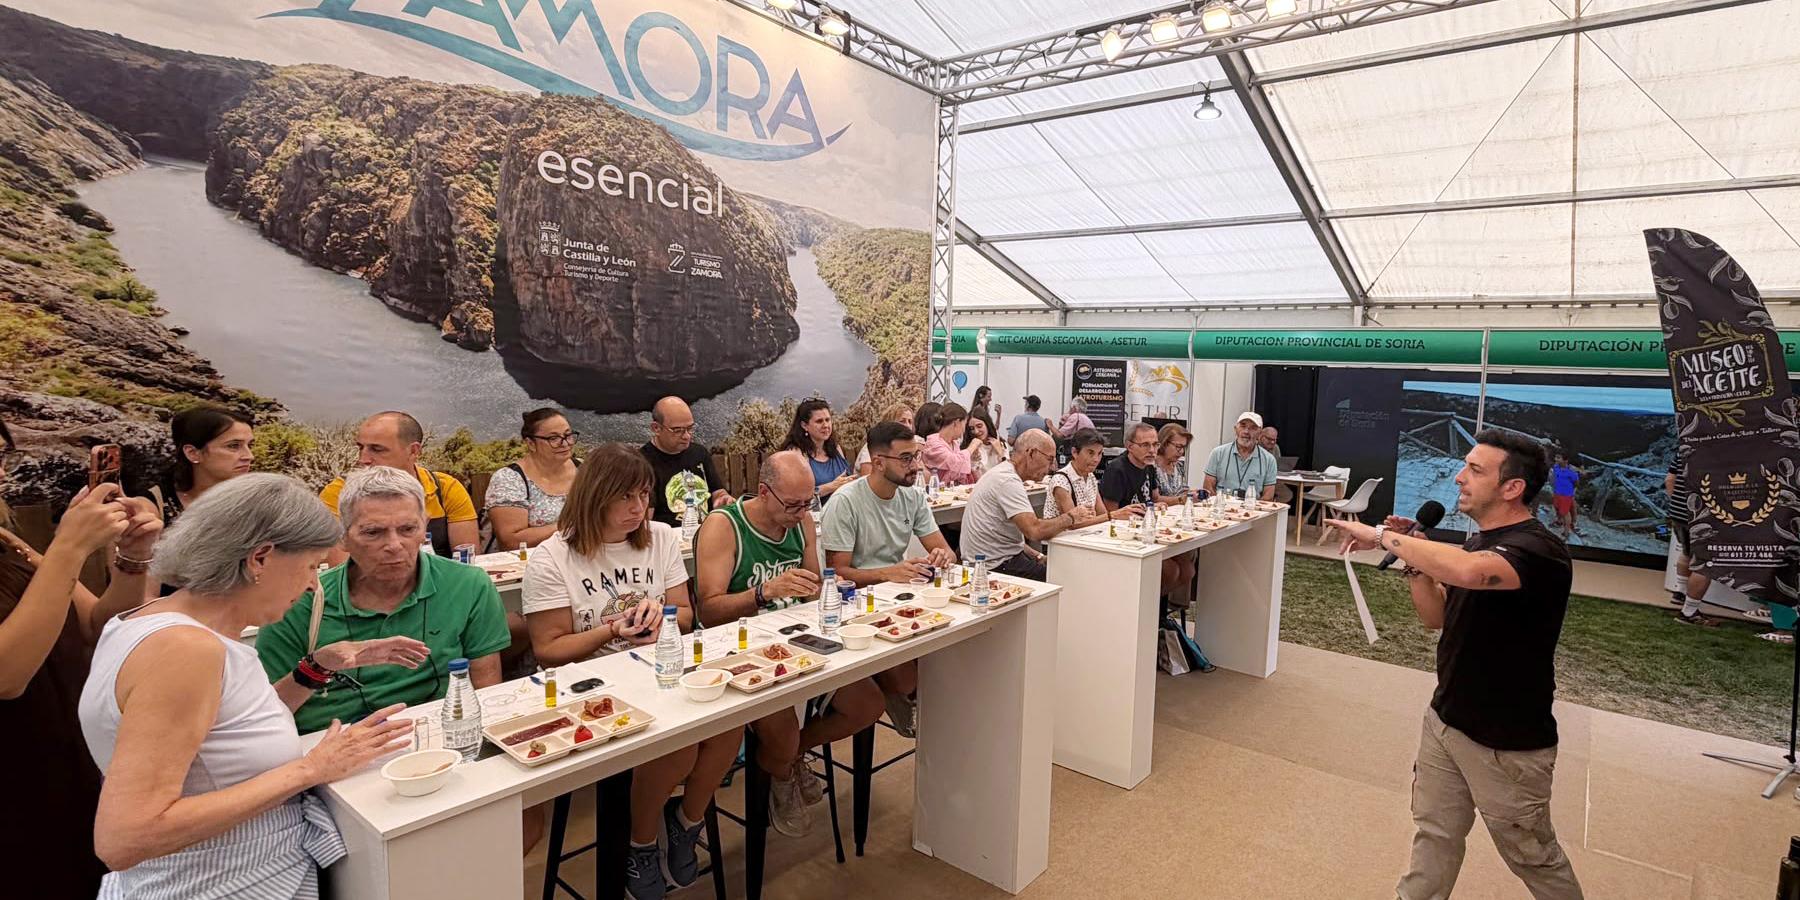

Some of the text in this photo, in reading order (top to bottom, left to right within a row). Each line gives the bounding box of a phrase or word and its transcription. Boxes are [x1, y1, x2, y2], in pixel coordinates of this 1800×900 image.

[537, 150, 723, 217] esencial
[563, 238, 609, 252] Junta de
[563, 249, 636, 267] Castilla y León
[694, 258, 721, 268] TURISMO
[564, 270, 588, 279] Turismo
[595, 274, 619, 282] Deporte
[607, 268, 629, 277] Cultura
[691, 267, 723, 279] ZAMORA
[998, 335, 1010, 344] CIT
[1013, 334, 1051, 344] CAMPIÑA
[1052, 336, 1103, 345] SEGOVIANA
[1111, 336, 1148, 346] ASETUR
[1287, 337, 1361, 348] PROVINCIAL
[1365, 338, 1381, 348] DE
[1385, 338, 1425, 349] SORIA
[1539, 338, 1643, 352] DIPUTACIÓN
[1681, 344, 1746, 377] MUSEO
[1689, 366, 1762, 397] ACEITE
[581, 567, 654, 597] RAMEN
